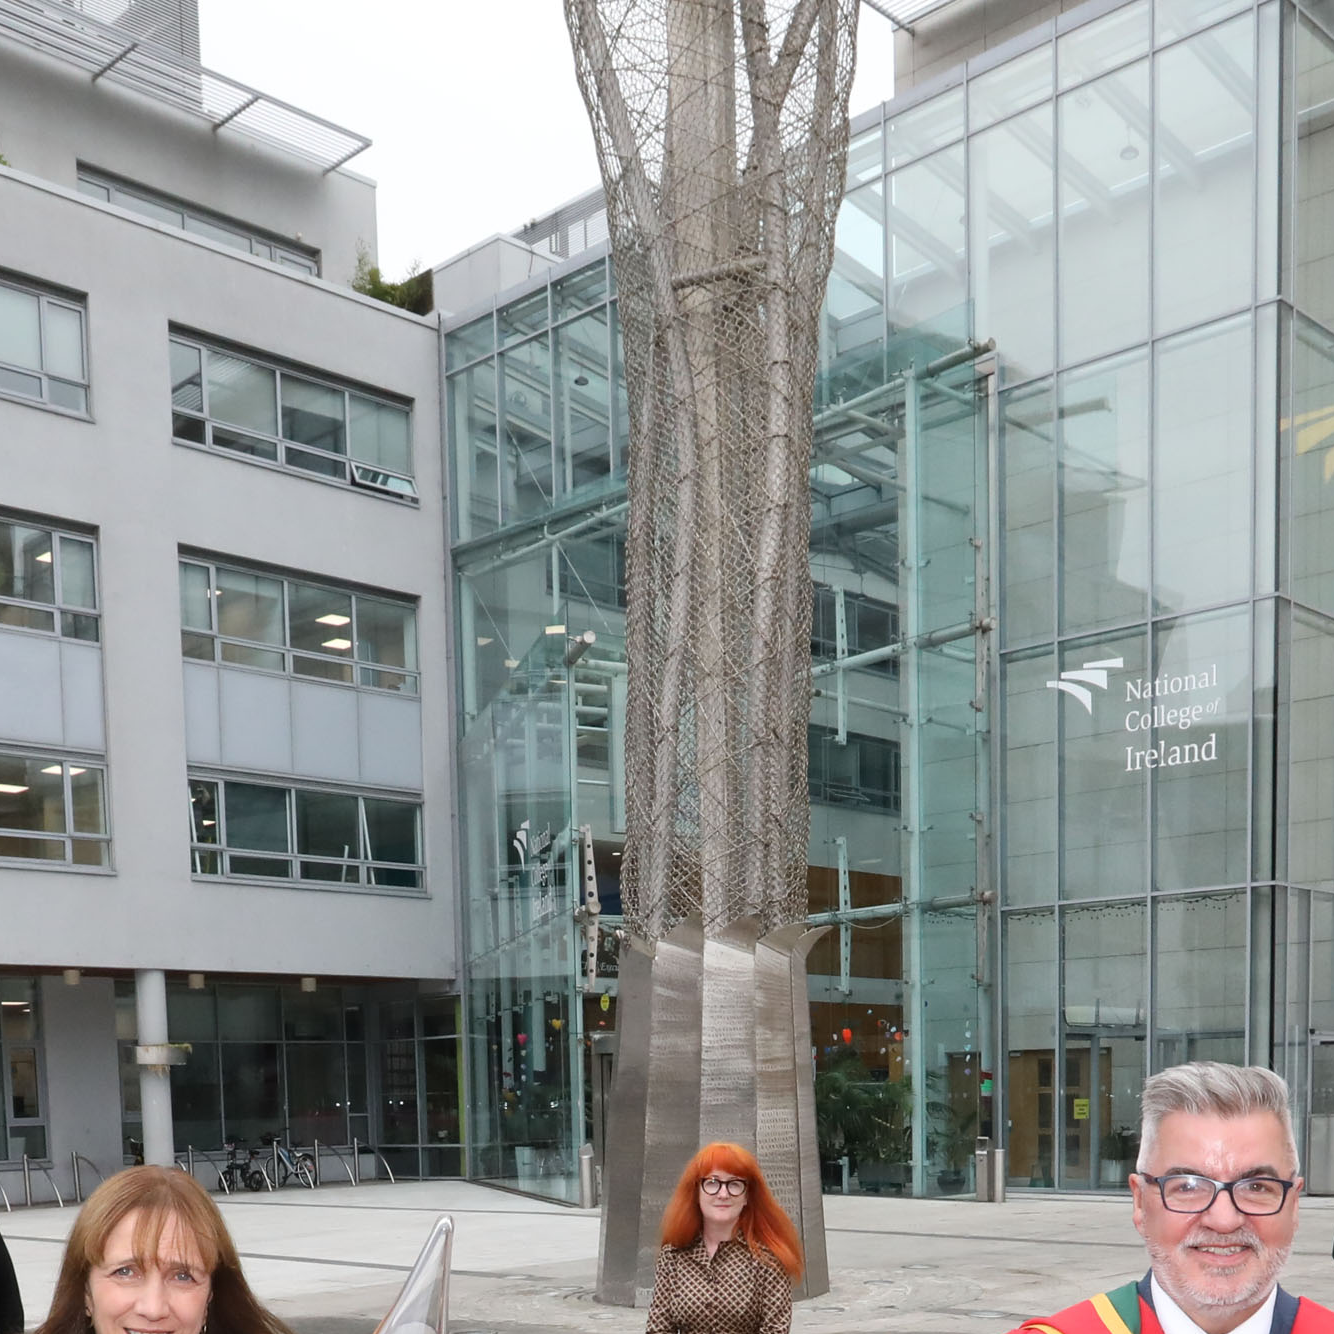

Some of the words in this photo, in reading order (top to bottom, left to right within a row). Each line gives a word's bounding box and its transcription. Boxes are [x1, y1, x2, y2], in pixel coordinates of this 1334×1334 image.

[1125, 664, 1217, 702] National
[1125, 705, 1202, 732] College
[1207, 697, 1221, 714] of
[1125, 733, 1217, 771] Ireland
